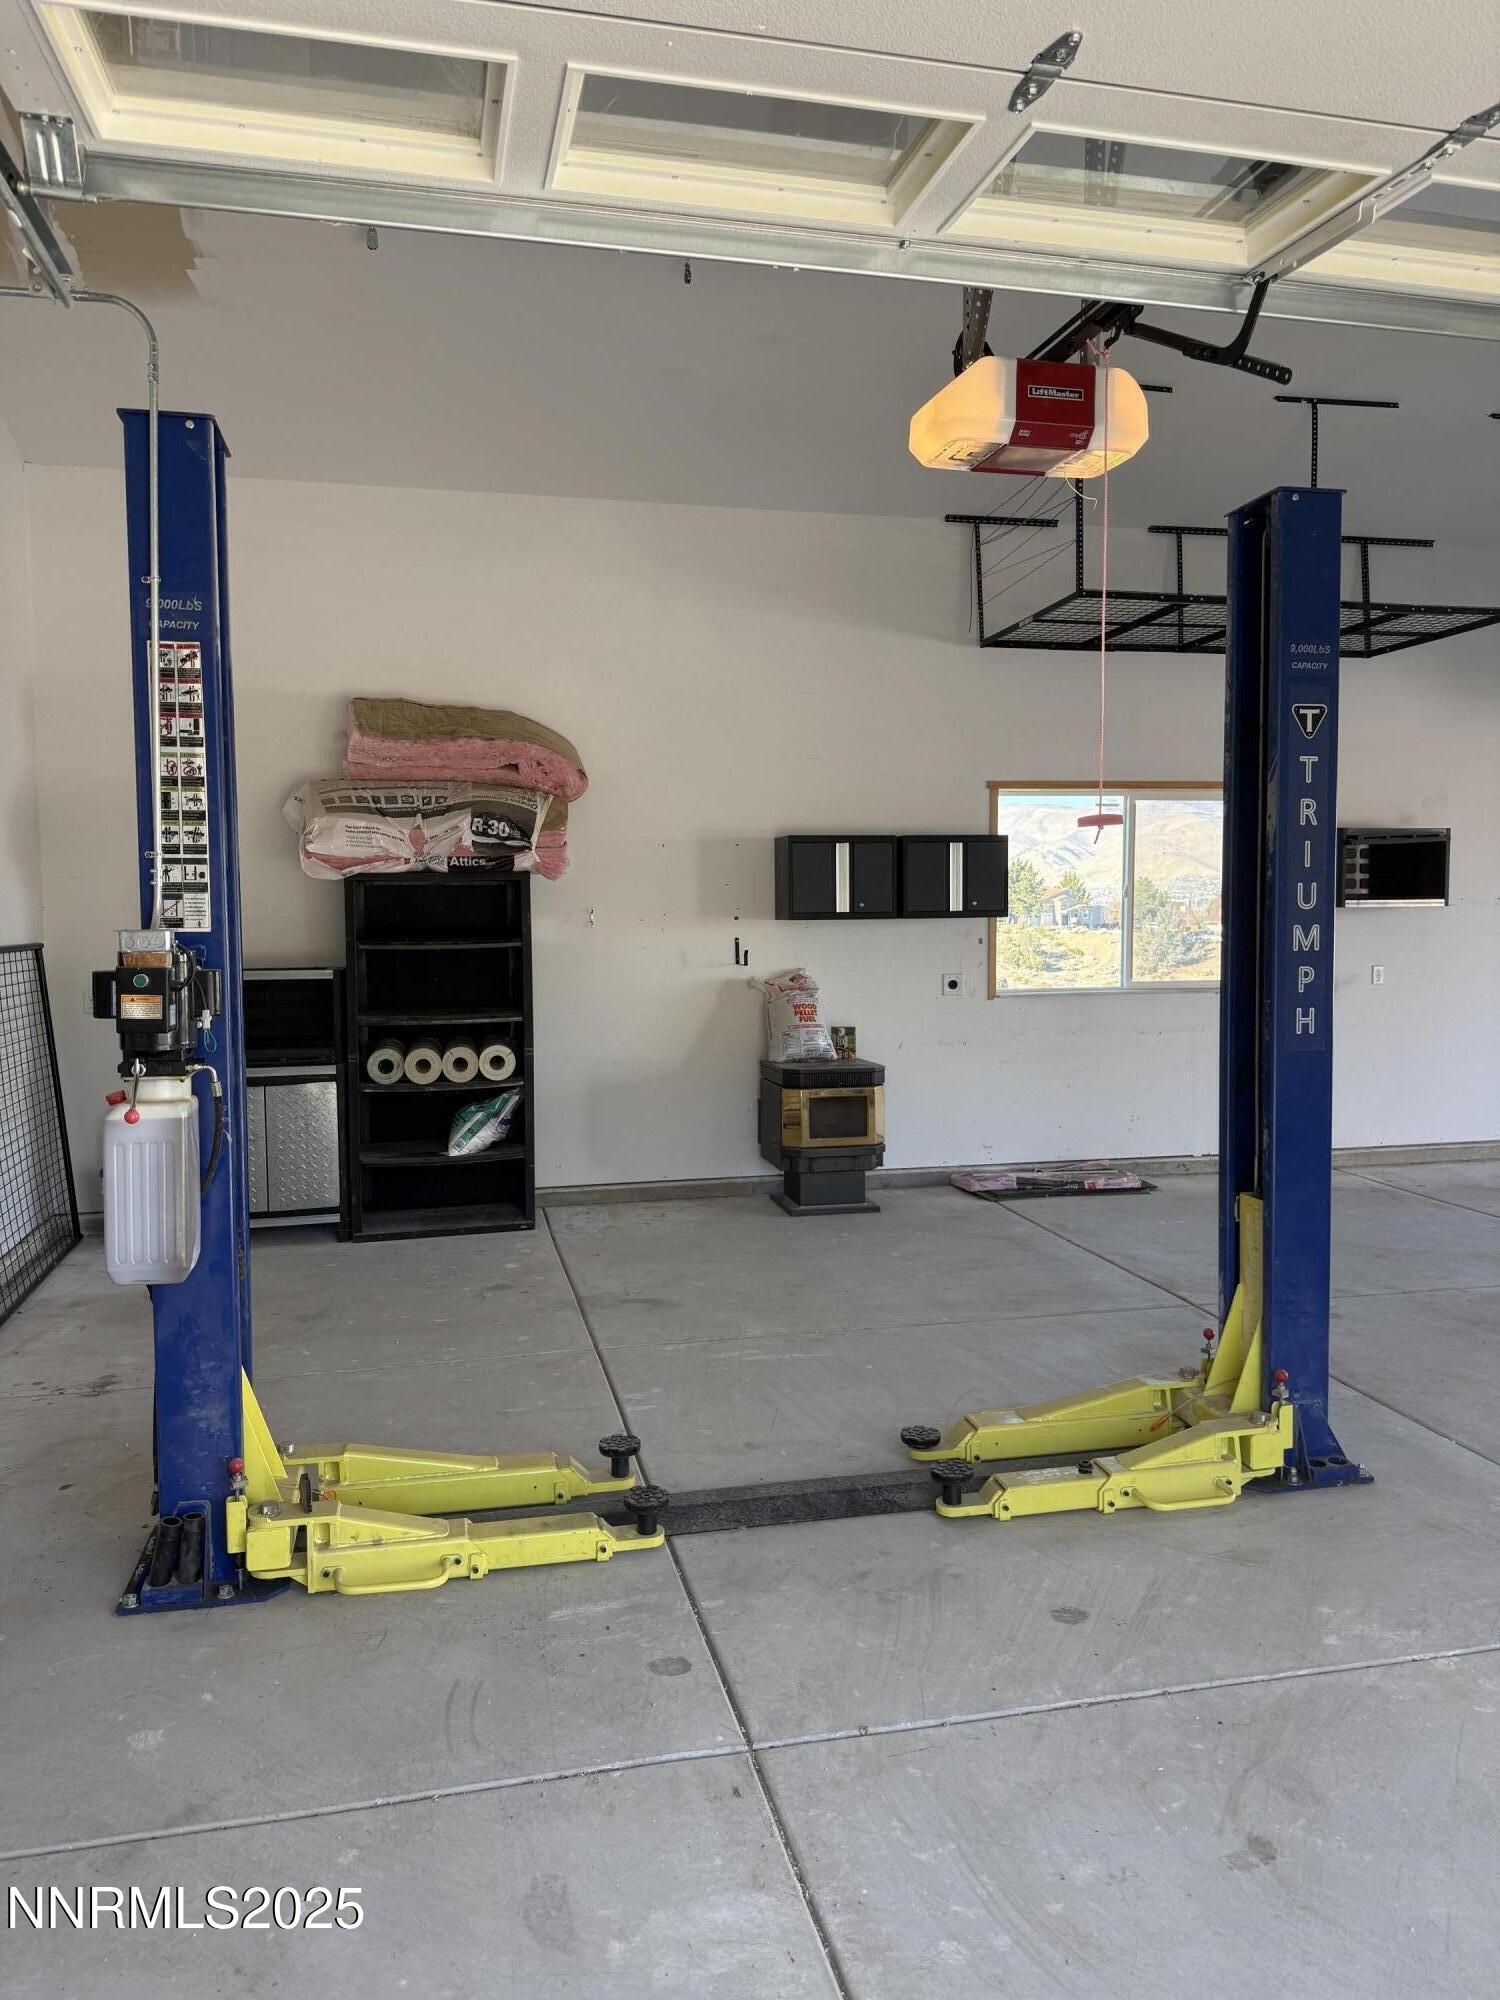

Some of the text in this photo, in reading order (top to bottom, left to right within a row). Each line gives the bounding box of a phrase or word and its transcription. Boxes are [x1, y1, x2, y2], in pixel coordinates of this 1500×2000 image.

[1031, 387, 1080, 398] LiftMaster
[1291, 661, 1328, 670] CAPACITY
[471, 817, 511, 838] R-30
[1292, 755, 1321, 1035] TRIUMPH
